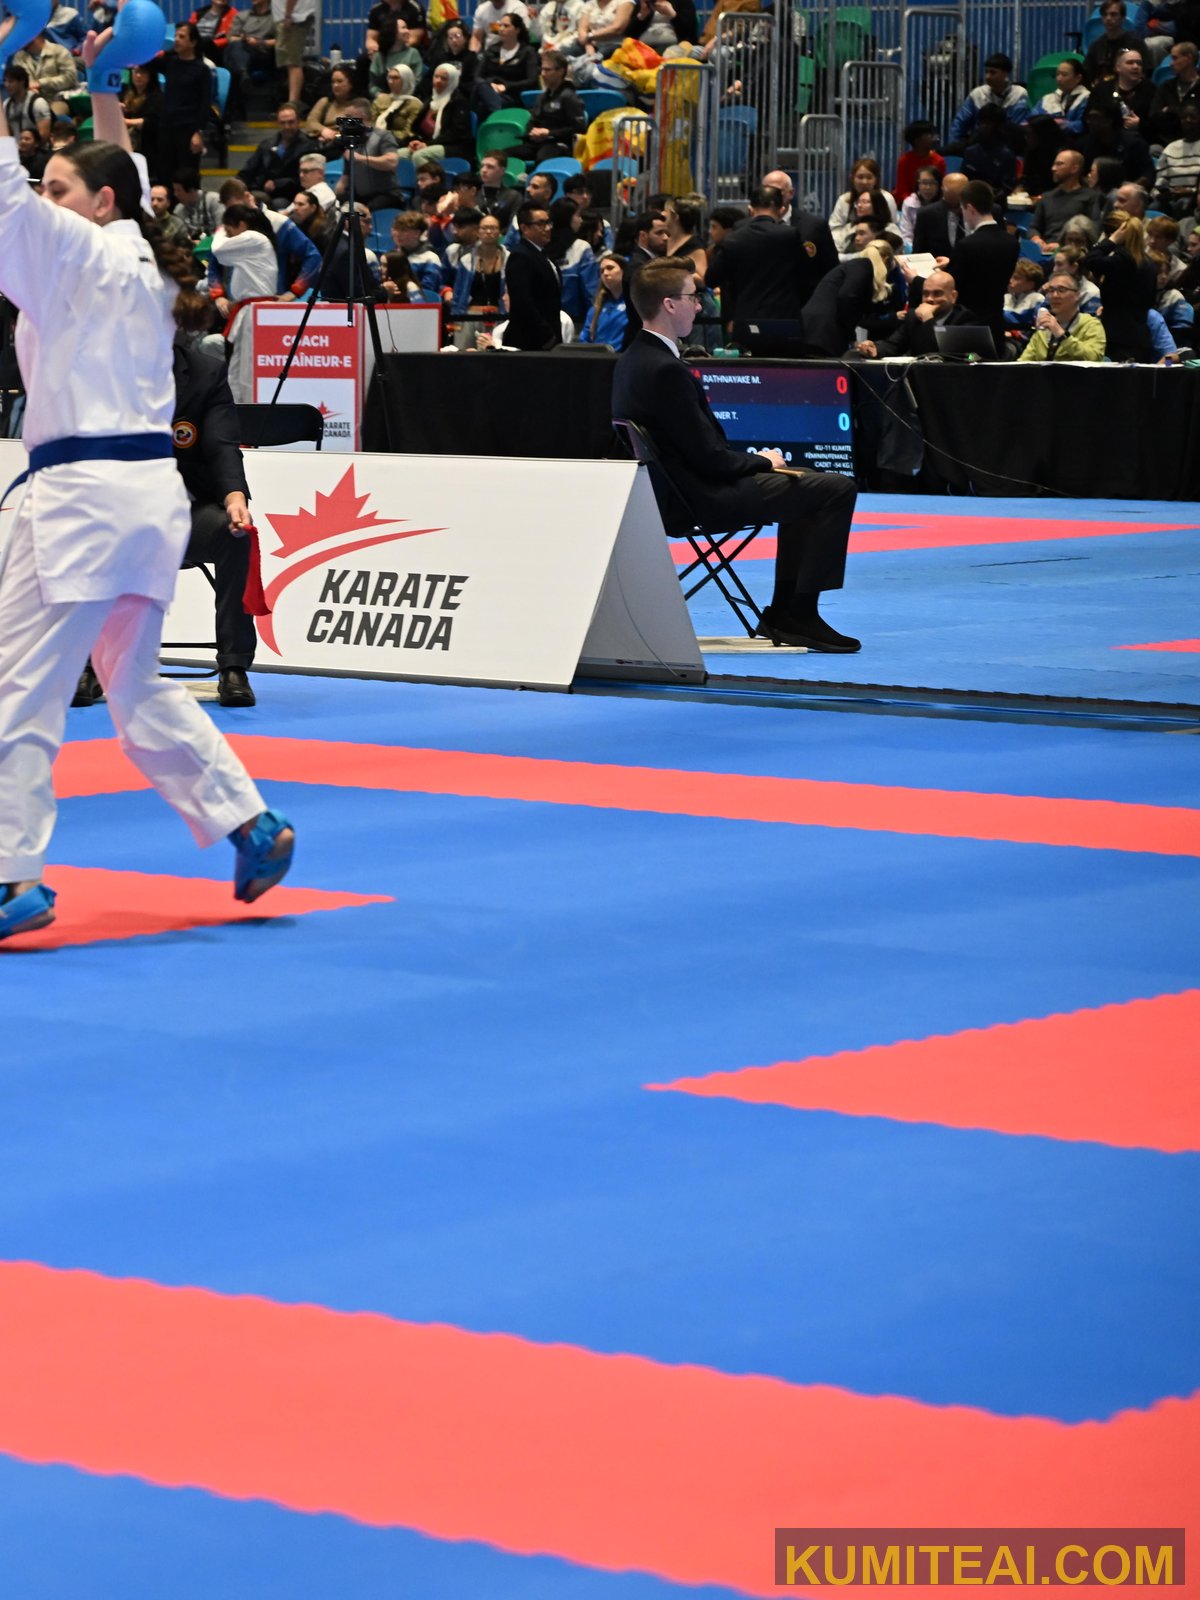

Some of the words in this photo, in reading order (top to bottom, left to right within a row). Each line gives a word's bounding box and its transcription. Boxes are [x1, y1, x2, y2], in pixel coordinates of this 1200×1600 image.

[702, 374, 750, 384] RATHNAYAKE
[836, 376, 848, 394] 0
[713, 411, 731, 420] NER
[838, 413, 850, 431] 0
[319, 569, 469, 610] KARATE
[306, 609, 453, 651] CANADA
